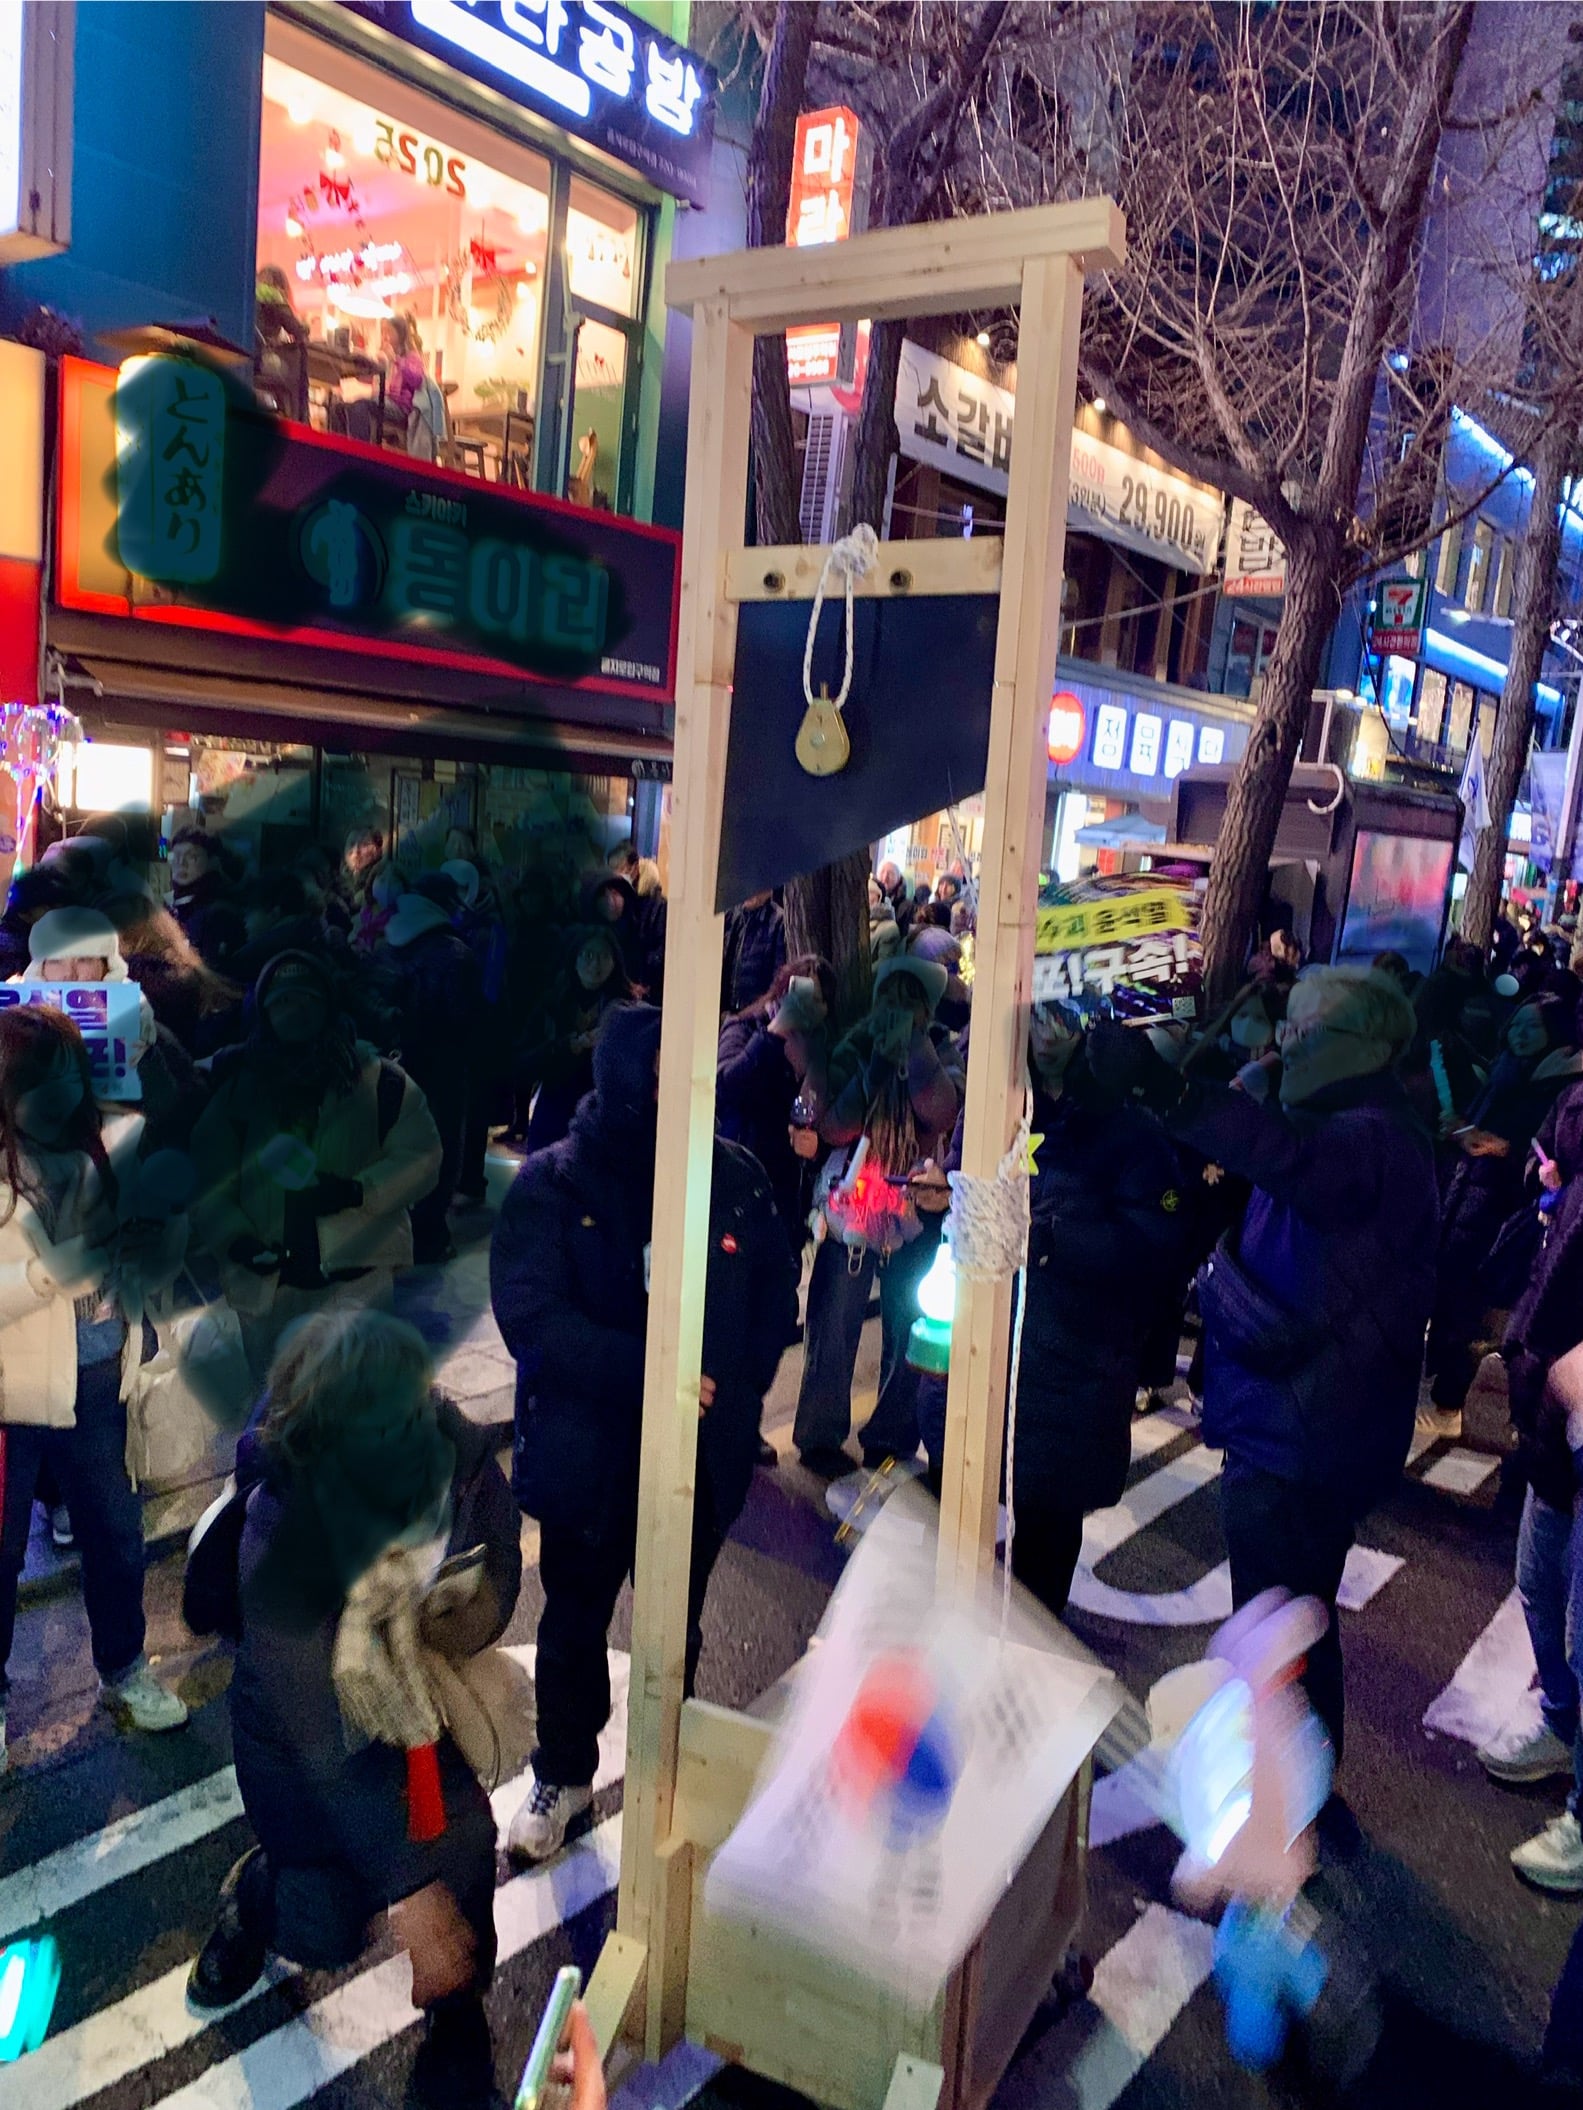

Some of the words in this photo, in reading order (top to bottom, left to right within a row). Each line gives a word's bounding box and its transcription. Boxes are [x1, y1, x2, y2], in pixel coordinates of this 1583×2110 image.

[466, 1, 701, 135] 라공방
[162, 375, 210, 556] とんあり
